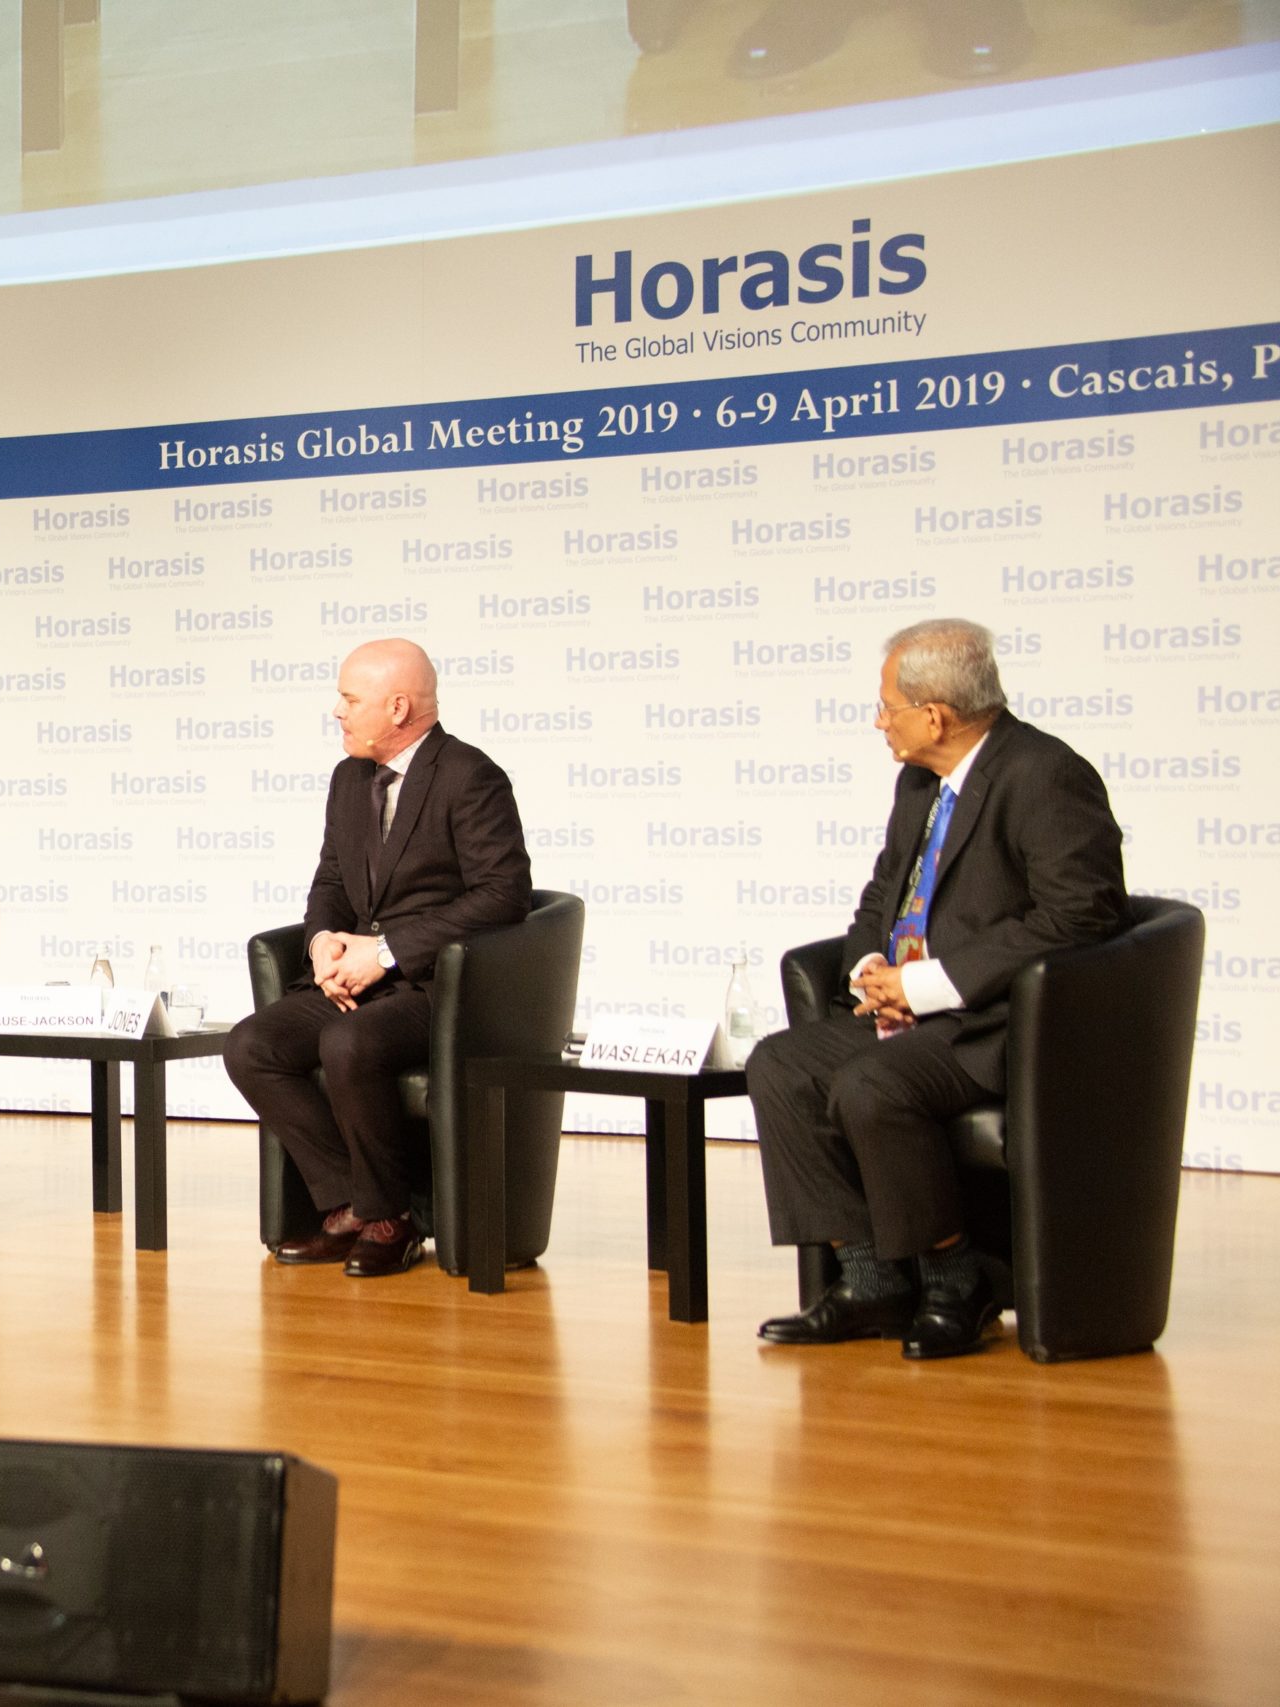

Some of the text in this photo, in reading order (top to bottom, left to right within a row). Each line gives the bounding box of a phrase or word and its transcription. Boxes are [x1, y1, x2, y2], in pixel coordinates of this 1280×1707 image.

[575, 218, 927, 327] Horasis
[576, 311, 927, 363] The Global Visions Community
[159, 432, 285, 470] Horasis
[297, 422, 415, 461] Global
[426, 411, 584, 453] Meeting
[596, 400, 679, 438] 2019
[715, 391, 778, 428] 6-9
[790, 380, 900, 433] April
[914, 370, 1006, 411] 2019
[1048, 350, 1233, 399] Cascais,
[1002, 429, 1135, 465] Horasis
[1200, 420, 1280, 449] Hora
[641, 460, 758, 492] Horasis
[813, 445, 936, 480] Horasis
[320, 483, 427, 512] Horasis
[478, 472, 589, 503] Horasis
[174, 493, 273, 522] Horasis
[915, 499, 1042, 533] Horasis
[1104, 484, 1243, 521] Horasis
[33, 504, 130, 531] Horasis
[731, 512, 851, 545] Horasis
[402, 533, 513, 563] Horasis
[564, 523, 678, 555] Horasis
[108, 551, 205, 580] Horasis
[250, 542, 353, 571] Horasis
[1198, 553, 1280, 583] Hora
[814, 570, 936, 603] Horasis
[1002, 559, 1134, 593] Horasis
[479, 589, 591, 618] Horasis
[643, 580, 759, 611] Horasis
[35, 611, 131, 638] Horasis
[175, 604, 273, 632] Horasis
[320, 597, 428, 625] Horasis
[1103, 617, 1241, 651] Horasis
[433, 649, 514, 675] orasis
[566, 643, 680, 672] Horasis
[733, 635, 852, 665] Horasis
[110, 661, 206, 688] Horasis
[251, 655, 338, 683] Horasi
[1198, 685, 1280, 713] Hora
[176, 714, 274, 740] Horasis
[480, 705, 593, 732] Horasis
[645, 700, 761, 728] Horasis
[37, 718, 132, 744] Horasis
[568, 760, 682, 787] Horasis
[735, 757, 853, 784] Horasis
[1102, 748, 1241, 780] Horasis
[111, 770, 207, 795] Horasis
[251, 769, 329, 793] Horas
[38, 826, 133, 850] Horasis
[177, 825, 275, 850] Horasis
[647, 820, 762, 847] Horasis
[1198, 817, 1280, 846] Hora
[112, 879, 207, 903] Horasis
[572, 878, 684, 904] Horasis
[736, 878, 853, 906] Horasis
[108, 1010, 141, 1034] JONES
[589, 1043, 697, 1067] WASLEKAR
[1201, 1083, 1280, 1113] Hora
